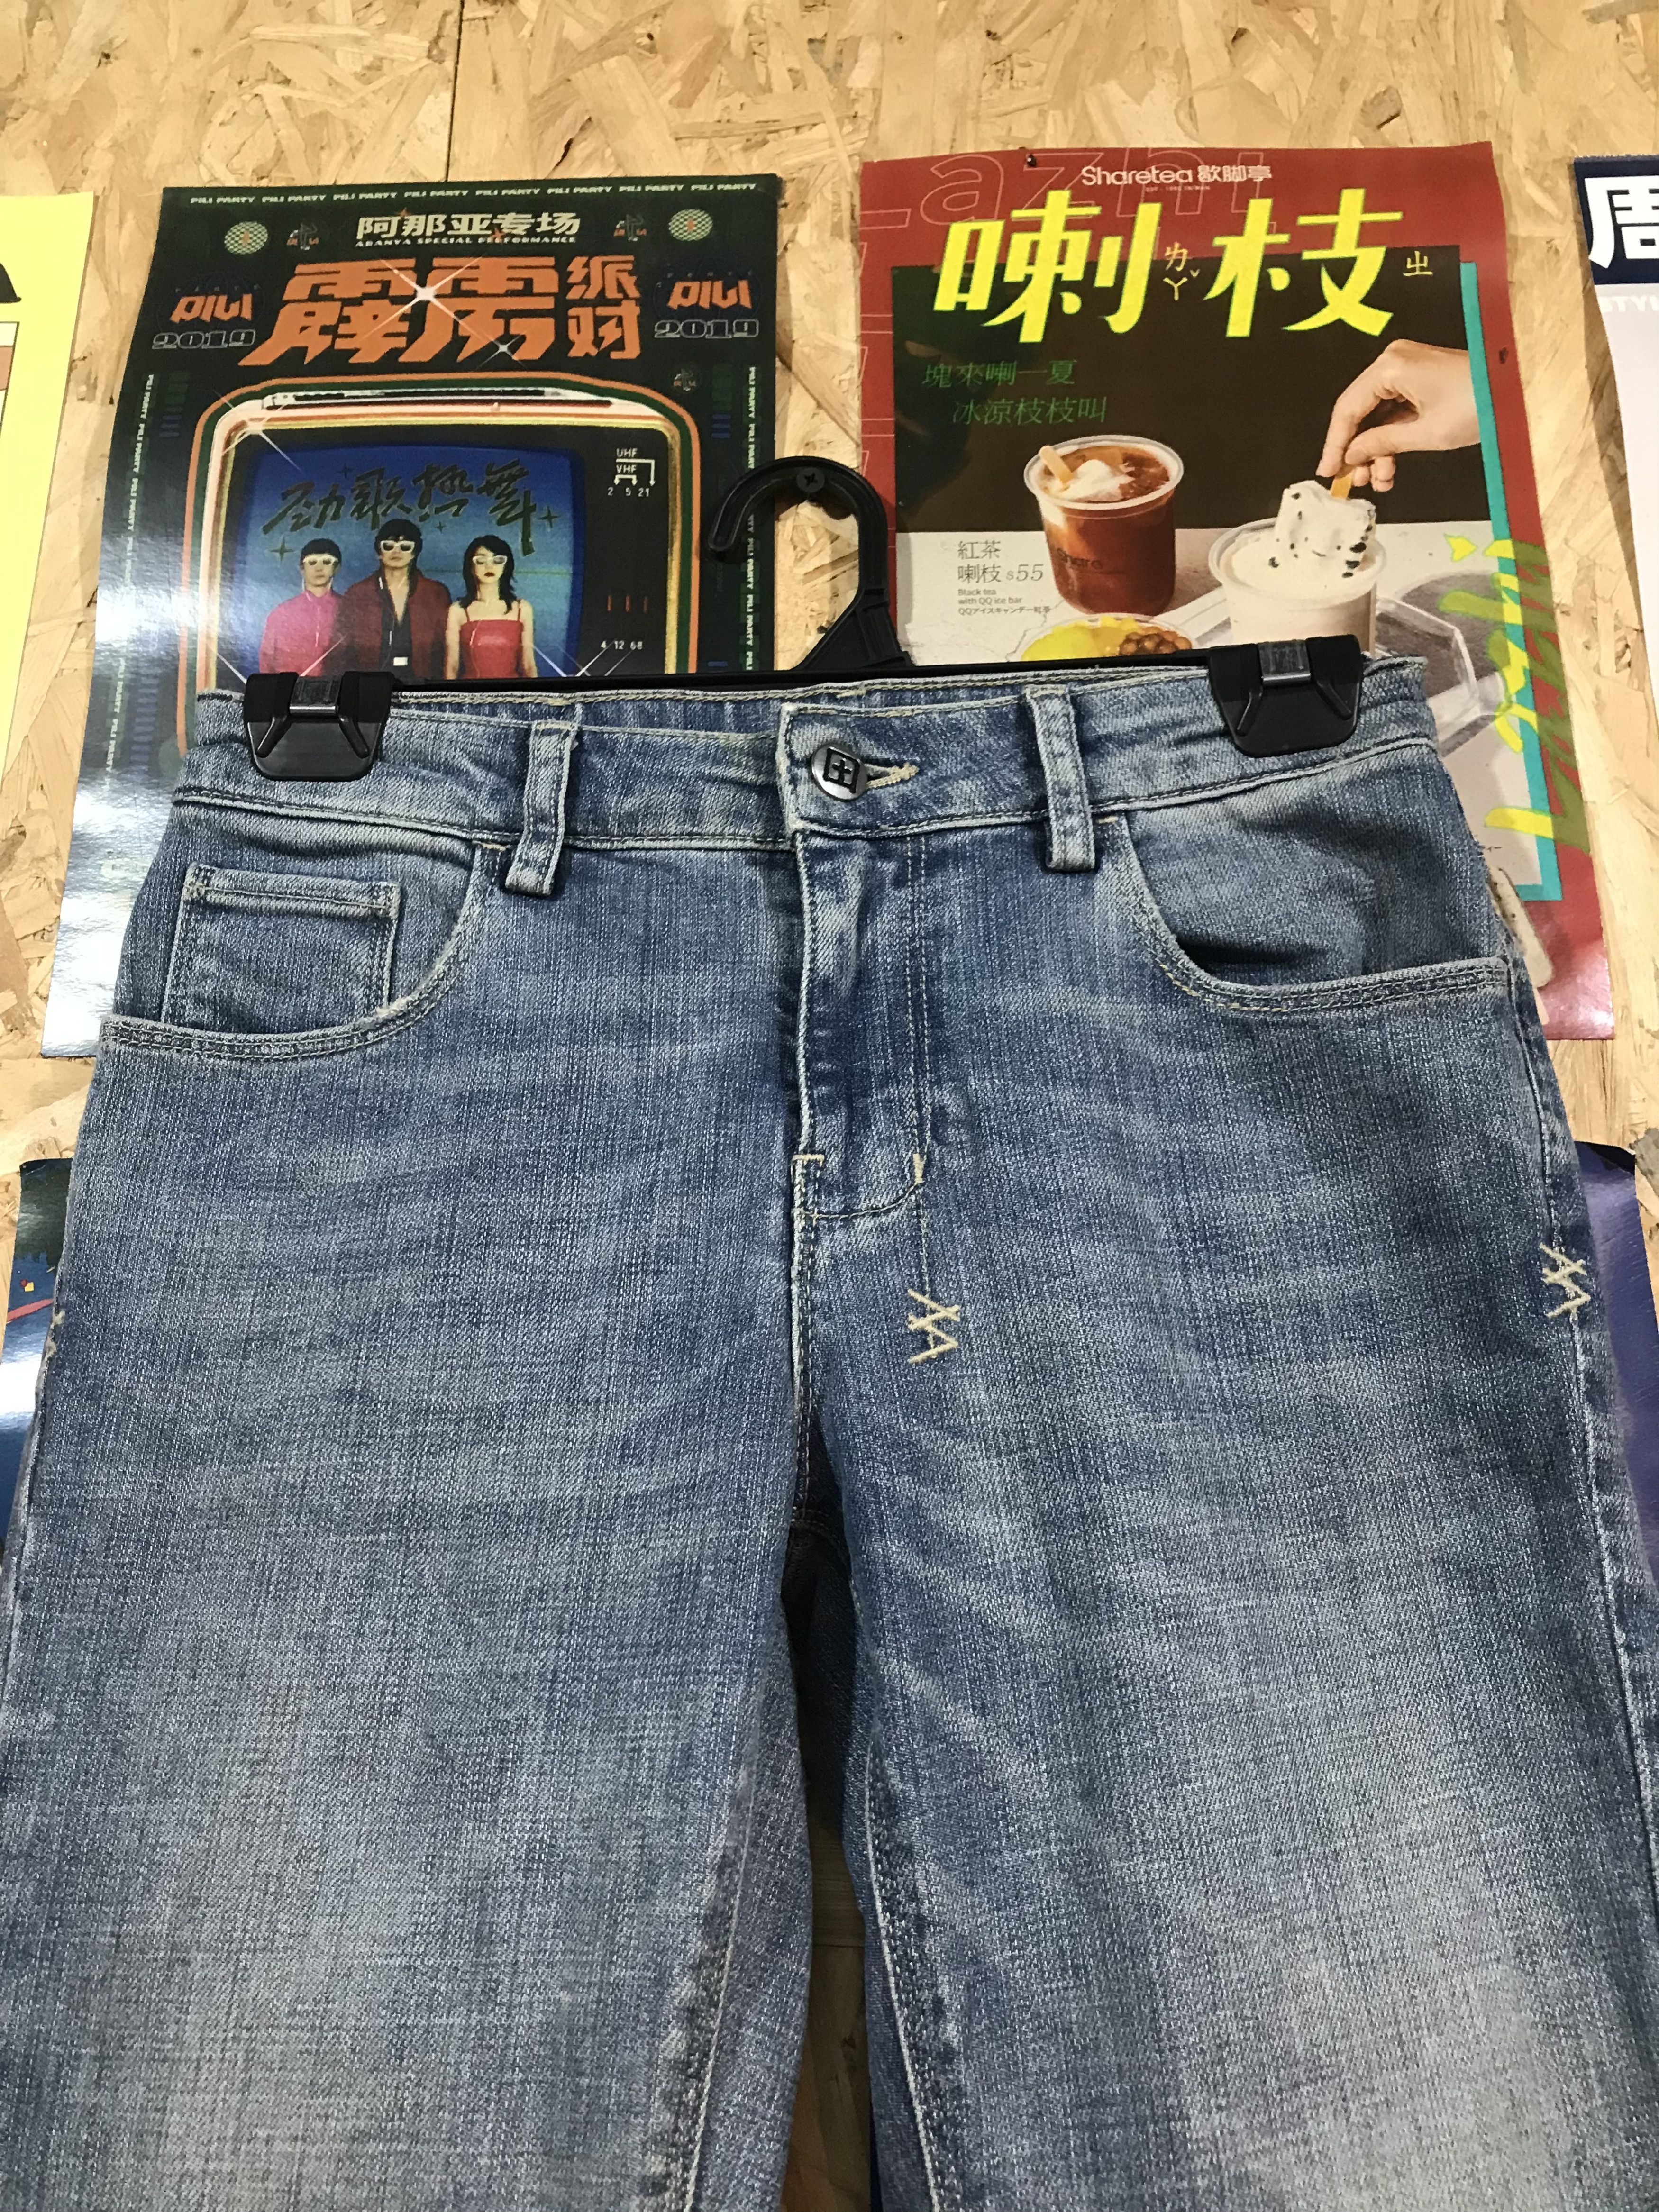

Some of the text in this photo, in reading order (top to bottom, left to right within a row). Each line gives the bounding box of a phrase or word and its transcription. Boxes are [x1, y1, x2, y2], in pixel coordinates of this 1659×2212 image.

[1082, 165, 1193, 185] Sharetea
[356, 212, 581, 239] 阿那亚专场
[355, 238, 411, 247] ARANYA
[654, 319, 759, 339] 2019
[152, 329, 256, 349] 2019
[616, 447, 638, 458] UHF
[616, 464, 638, 473] VHF
[607, 487, 614, 496] 2
[638, 487, 649, 497] 21
[957, 540, 1001, 560] 紅茶
[957, 564, 1001, 583] 喇枝
[979, 597, 992, 605] QQ
[614, 640, 624, 649] 12
